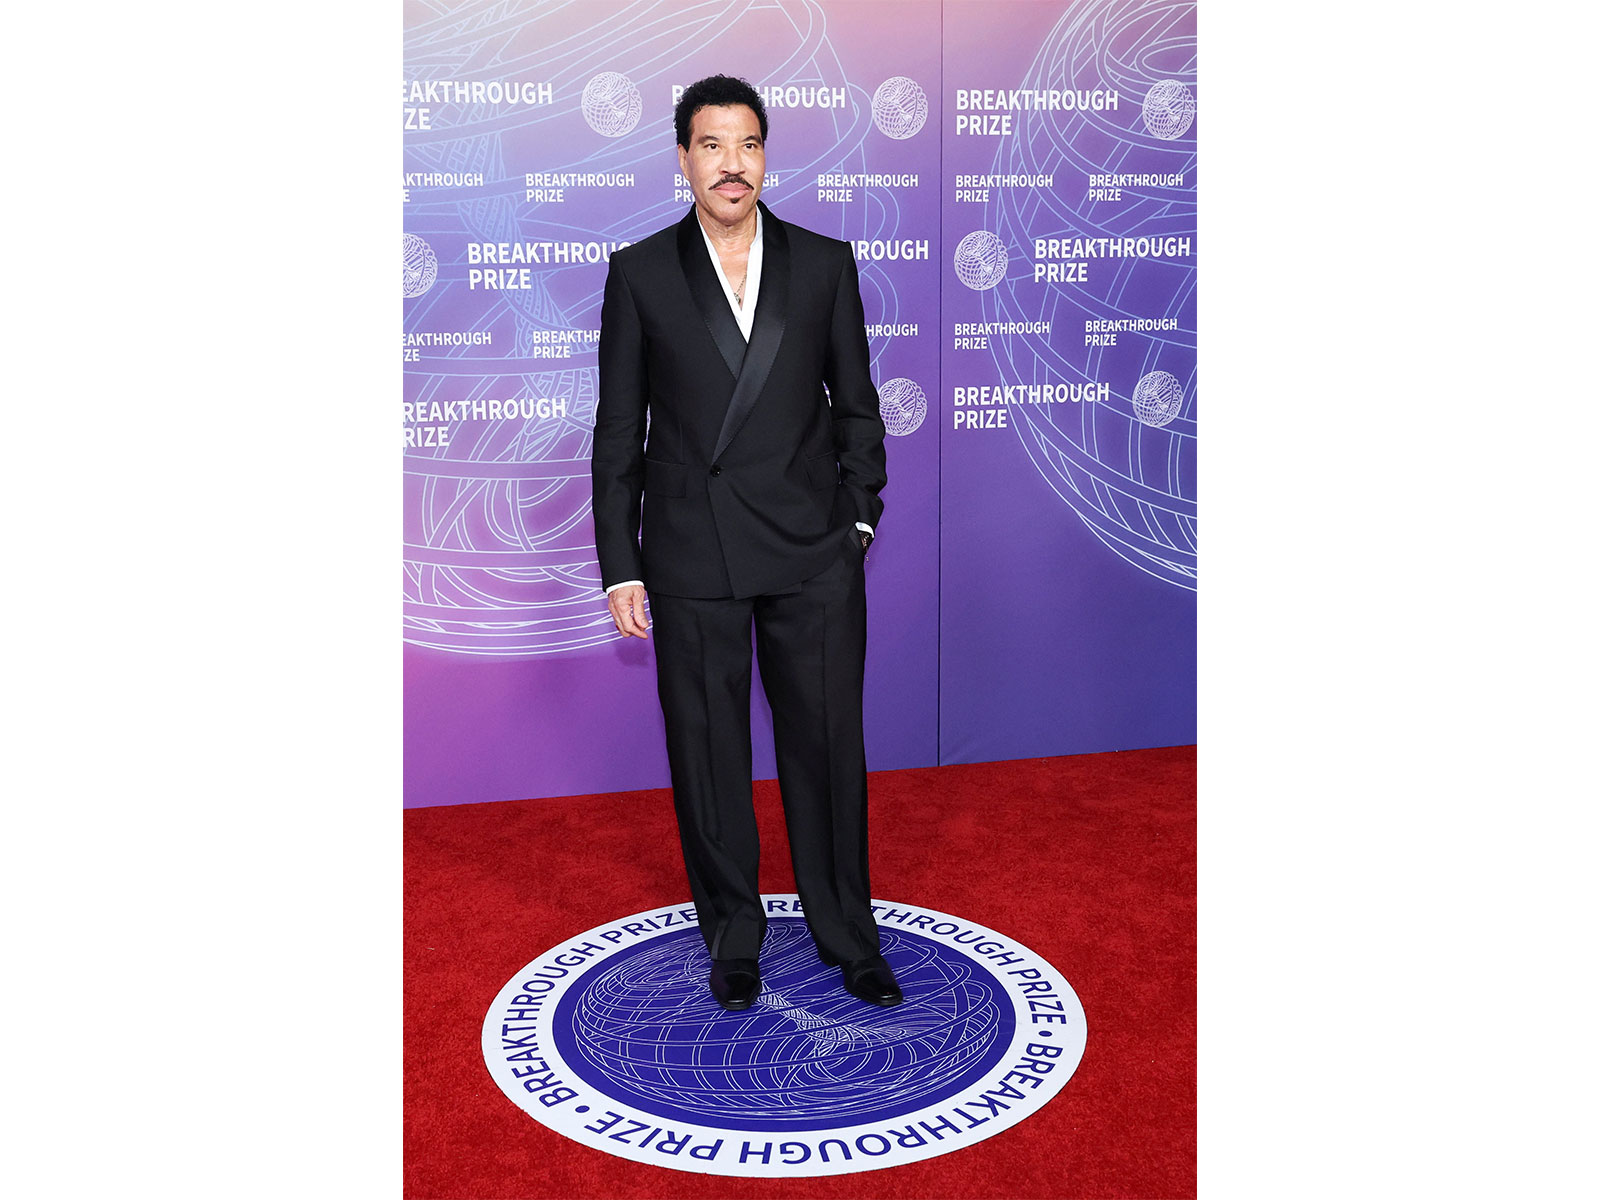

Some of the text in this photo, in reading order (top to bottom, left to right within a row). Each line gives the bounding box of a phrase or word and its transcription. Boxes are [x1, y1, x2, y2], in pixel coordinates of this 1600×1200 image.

[403, 81, 553, 105] AKTHROUGH
[672, 85, 846, 108] BHROUGH
[956, 89, 1119, 111] BREAKTHROUGH
[956, 115, 1012, 135] PRIZE
[403, 173, 484, 187] KTHROUGH
[525, 173, 635, 187] BREAKTHROUGH
[817, 174, 919, 187] BREAKTHROUGH
[955, 175, 1053, 188] BREAKTHROUGH
[1089, 174, 1184, 187] BREAKTHROUGH
[526, 189, 564, 202] PRIZE
[817, 189, 853, 202] PRIZE
[955, 190, 989, 202] PRIZE
[1089, 189, 1122, 201] PRIZE
[468, 242, 640, 264] BREAKTHROU
[1035, 237, 1191, 259] BREAKTHROUGH
[469, 268, 532, 290] PRIZE
[1034, 263, 1088, 283] PRIZE
[955, 322, 1050, 336] BREAKTHROUGH
[1085, 319, 1178, 333] BREAKTHROUGH
[403, 332, 492, 346] AKTHROUGH
[533, 330, 601, 344] BREAKTHR
[954, 338, 988, 350] PRIZE
[1085, 334, 1117, 346] PRIZE
[533, 346, 571, 359] PRIZE
[954, 383, 1110, 406] BREAKTHROUGH
[403, 398, 567, 423] REAKTHROUGH
[954, 409, 1007, 430] PRIZE
[403, 426, 450, 448] RIZE
[1007, 968, 1067, 1025] PRIZE
[502, 908, 698, 1108] BREAKTHROUGH PRIZE
[584, 1042, 1064, 1165] BREAKTHROUGH PRIZE
